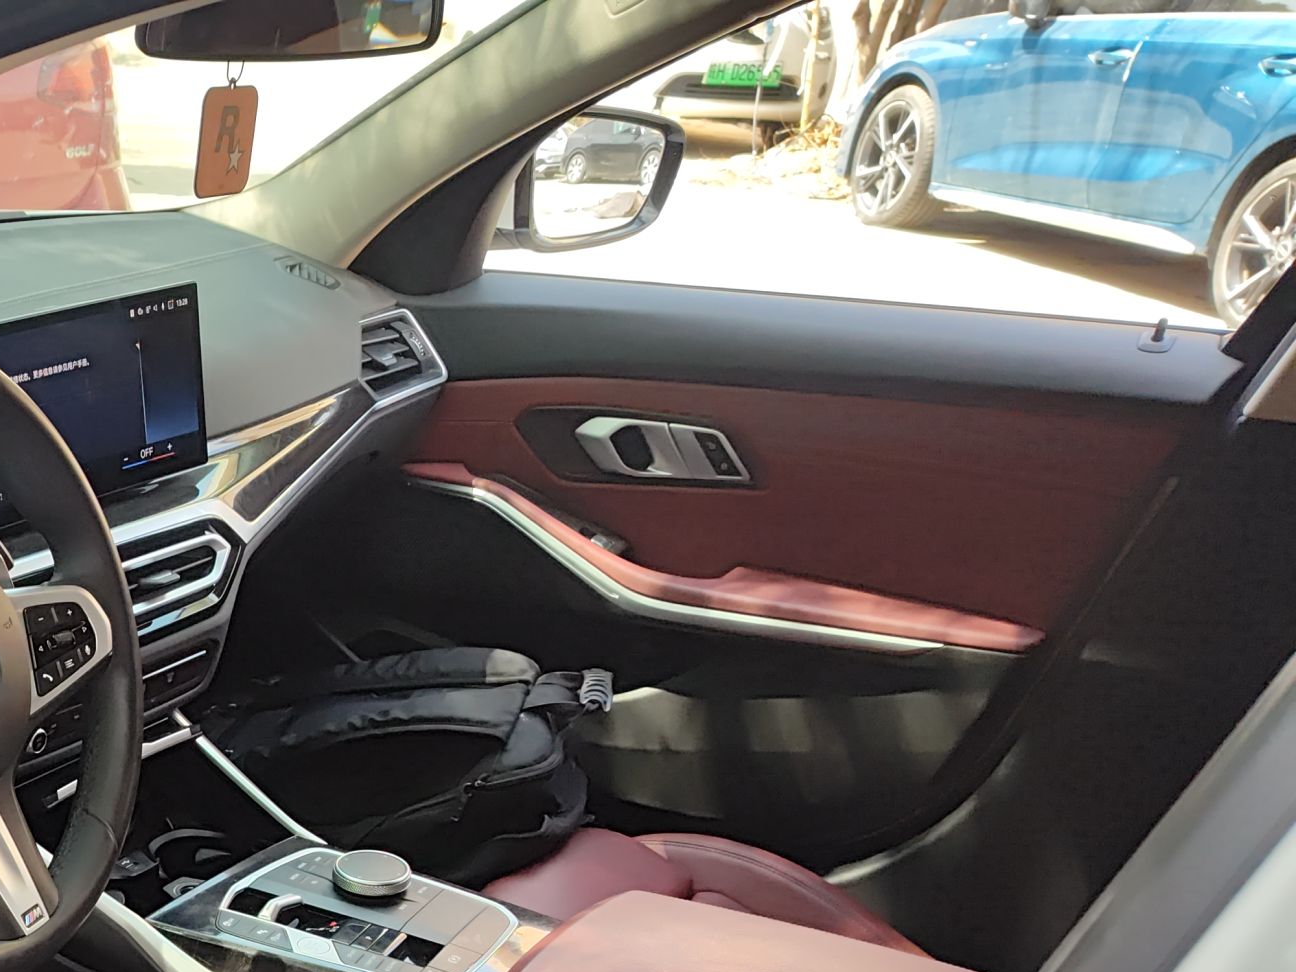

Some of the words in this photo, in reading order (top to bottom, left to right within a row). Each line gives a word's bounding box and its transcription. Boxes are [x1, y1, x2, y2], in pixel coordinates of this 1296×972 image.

[215, 105, 240, 153] R
[65, 143, 95, 159] GOLF
[140, 446, 154, 459] OFF
